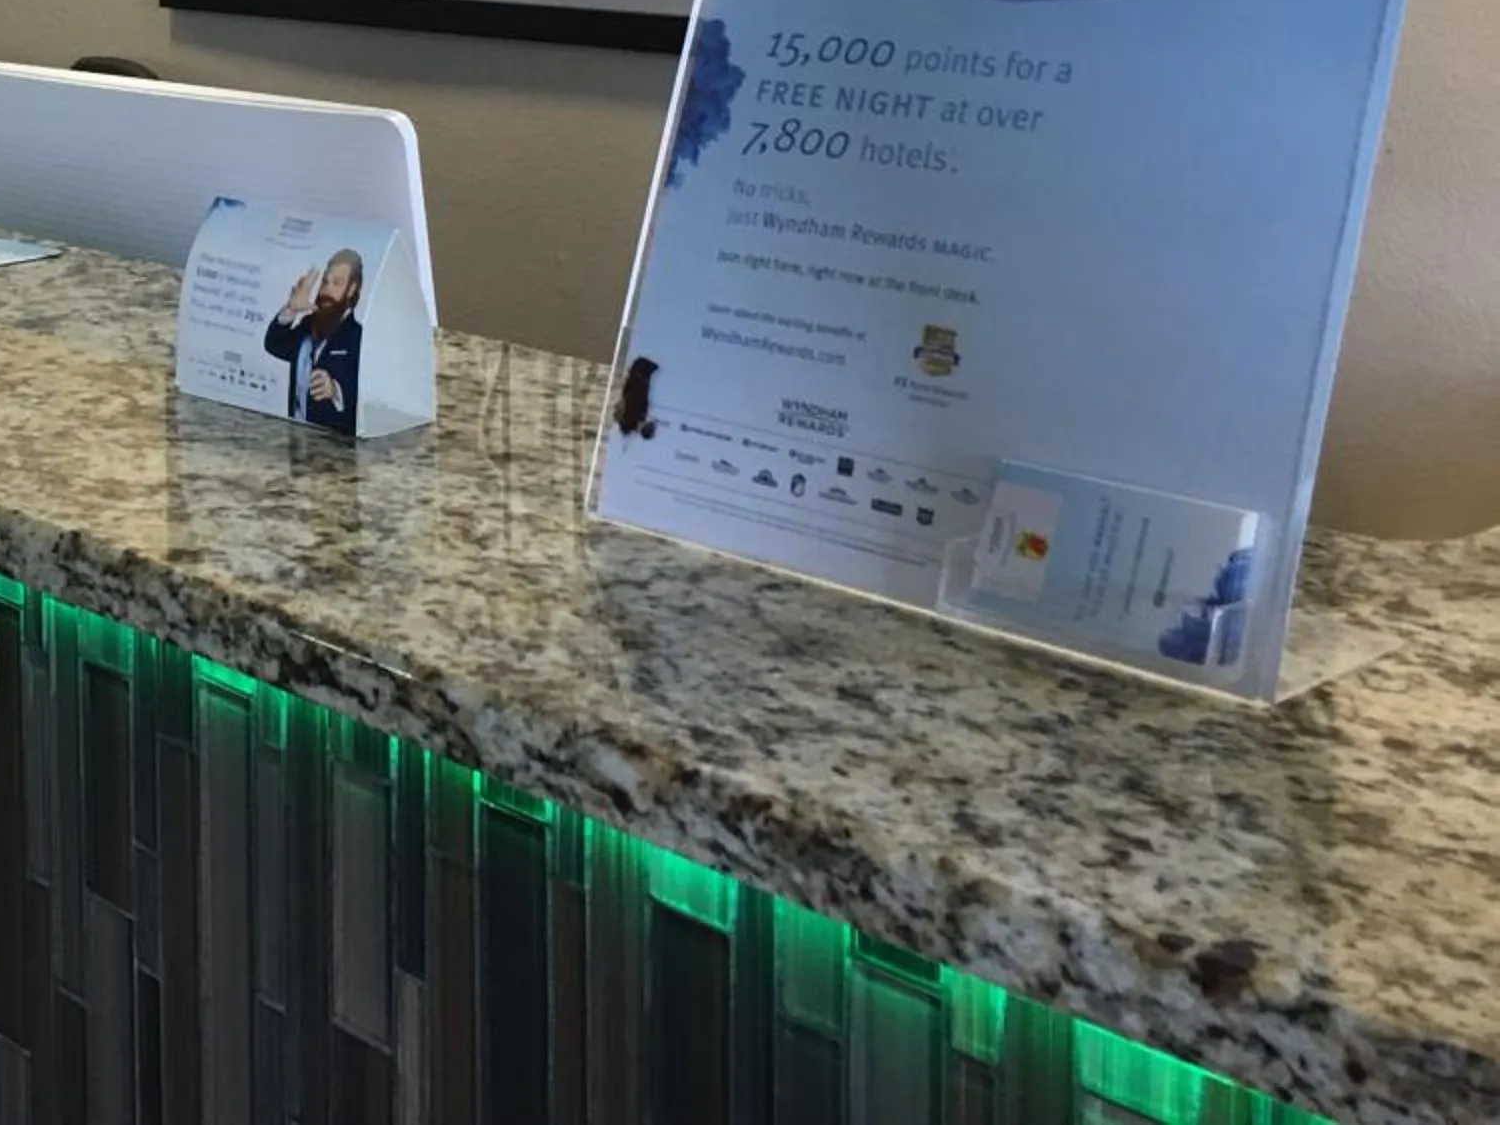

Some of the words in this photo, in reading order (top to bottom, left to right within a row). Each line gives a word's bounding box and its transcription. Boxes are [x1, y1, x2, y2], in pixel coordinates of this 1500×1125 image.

[766, 32, 896, 68] 15,000
[904, 45, 997, 78] points
[1005, 49, 1049, 83] for
[1054, 61, 1073, 85] a
[756, 79, 826, 108] FREE
[835, 86, 935, 120] NIGHT
[940, 99, 969, 124] at
[976, 106, 1044, 132] over
[740, 117, 850, 159] 7,800
[858, 134, 959, 174] hotels.
[733, 177, 755, 197] No
[762, 211, 846, 241] Wyndham
[850, 223, 927, 253] Rewards
[780, 397, 848, 421] WYNDHAM
